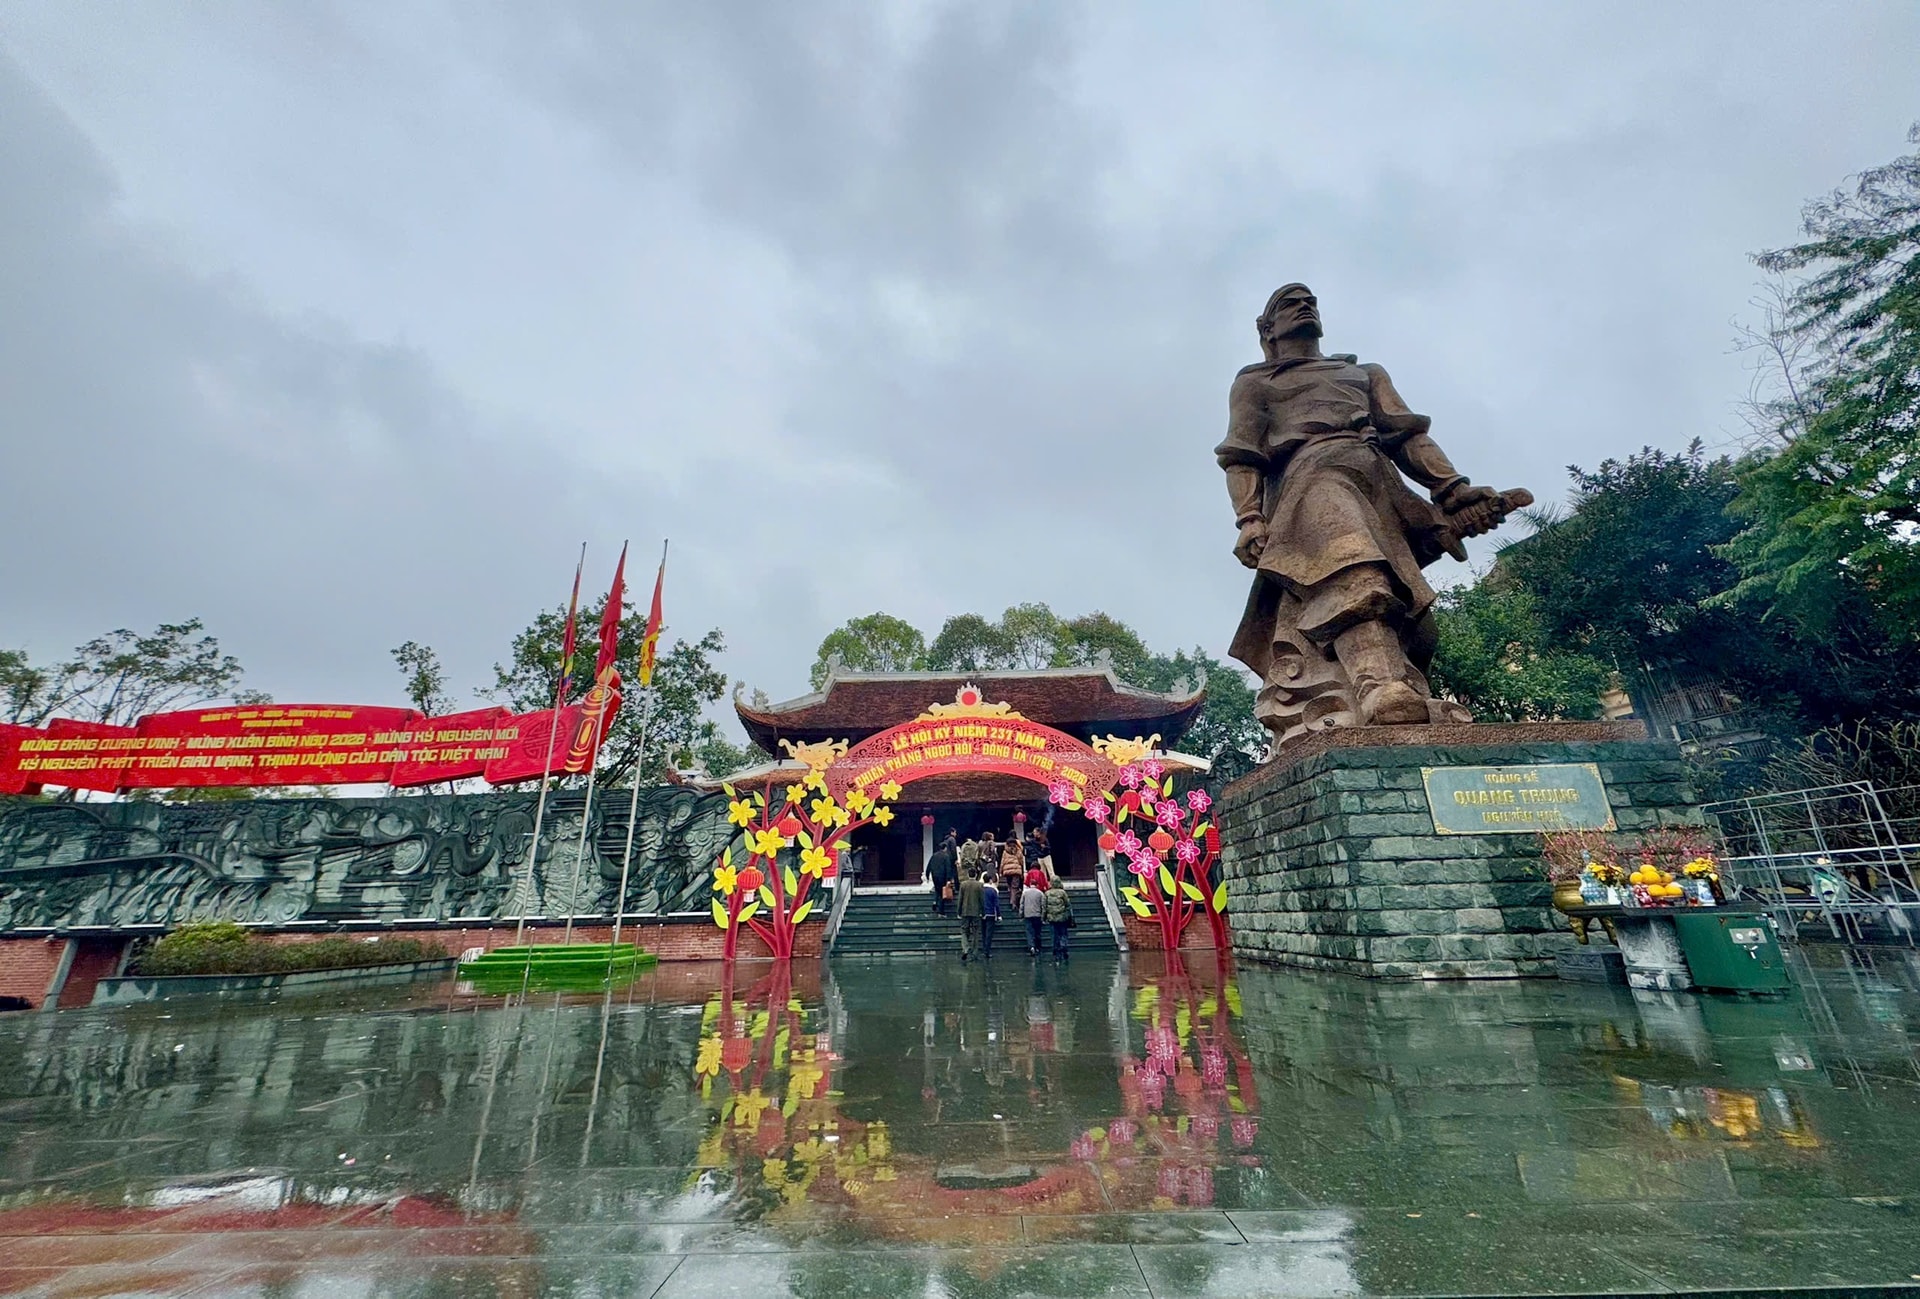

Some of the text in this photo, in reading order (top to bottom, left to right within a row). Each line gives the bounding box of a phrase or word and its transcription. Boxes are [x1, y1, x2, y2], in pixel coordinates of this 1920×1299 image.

[19, 736, 60, 751] MỪNG
[59, 735, 99, 750] ĐẢNG
[98, 737, 148, 750] QUANG
[146, 737, 181, 749] VINH
[187, 734, 225, 749] MỪNG
[226, 733, 266, 748] XUÂN
[265, 732, 299, 747] BÍNH
[300, 734, 329, 749] NGỌ
[373, 729, 413, 745] MỪNG
[435, 727, 494, 742] NGUYÊN
[495, 725, 519, 740] MỚI
[990, 727, 1013, 741] 237
[39, 754, 99, 770] NGUYÊN
[98, 754, 138, 769] PHÁT
[138, 751, 180, 768] TRIỂN
[179, 752, 213, 768] GIÀU
[258, 754, 300, 769] THỊNH
[300, 751, 349, 768] VƯỢNG
[347, 748, 379, 764] CỦA
[378, 747, 409, 763] DÂN
[410, 746, 439, 764] TỘC
[440, 745, 473, 763] VIỆT
[474, 747, 510, 760] NAM!
[1453, 788, 1581, 805] QUANG TRUNG
